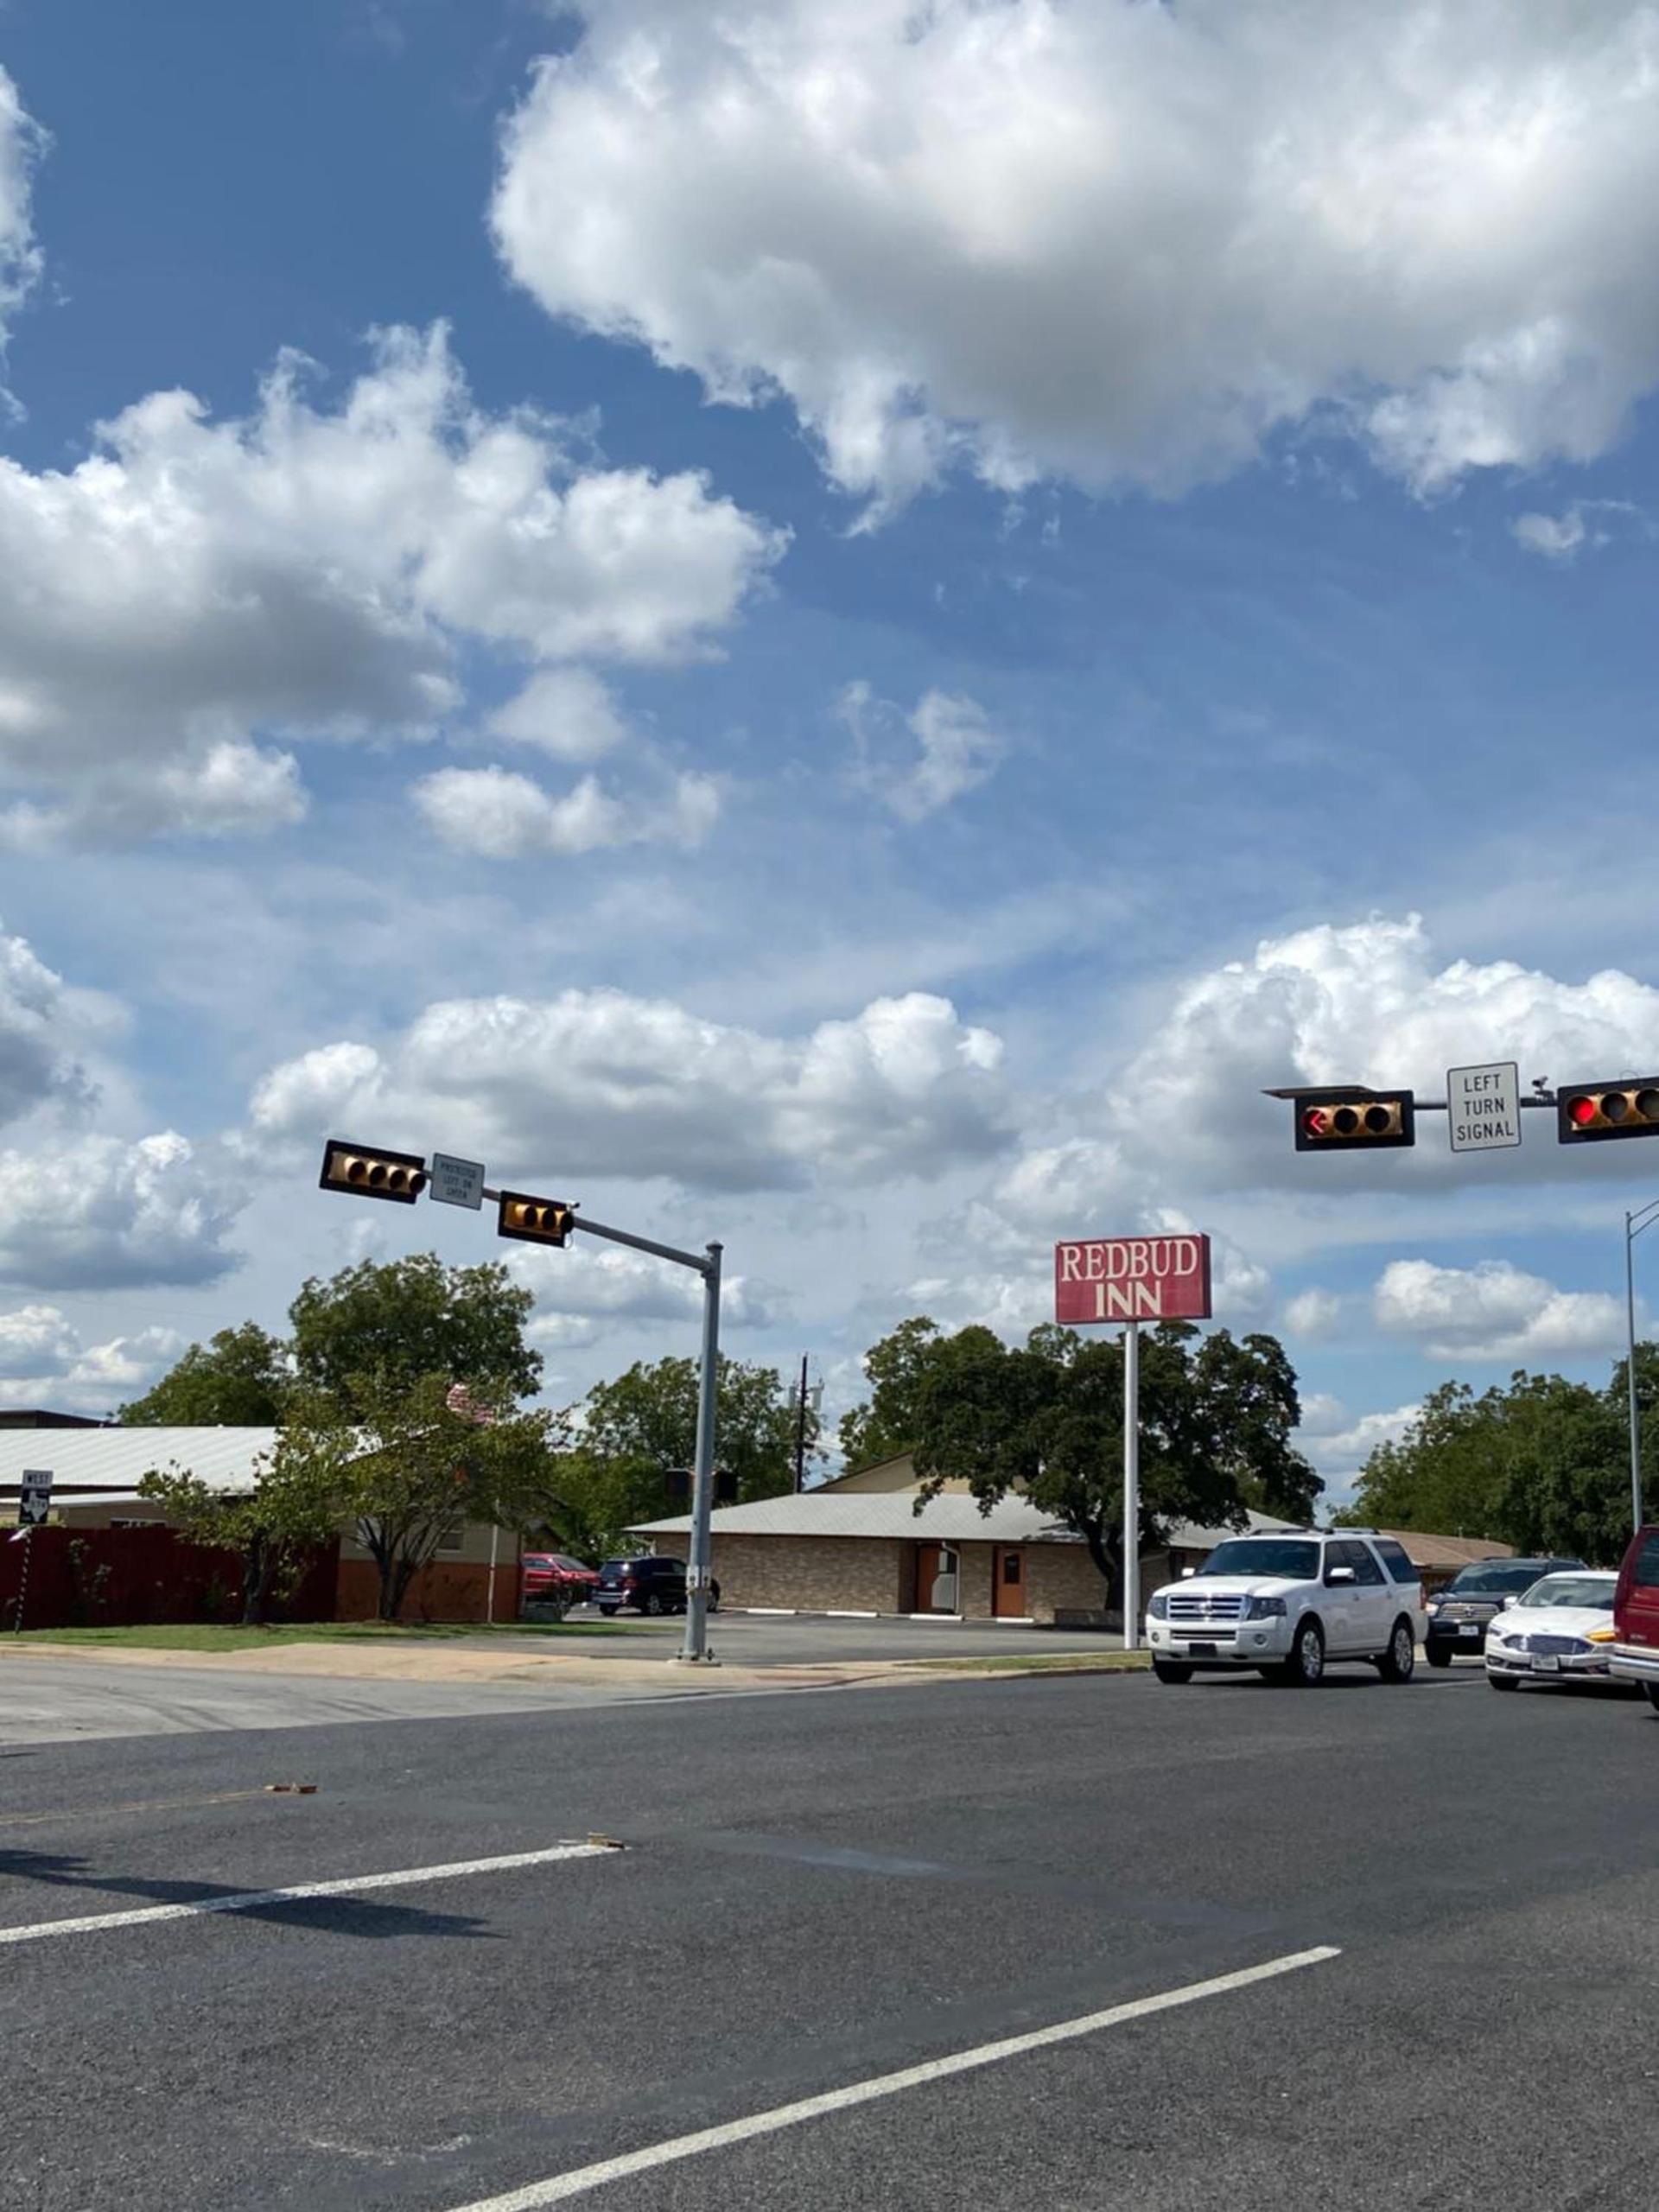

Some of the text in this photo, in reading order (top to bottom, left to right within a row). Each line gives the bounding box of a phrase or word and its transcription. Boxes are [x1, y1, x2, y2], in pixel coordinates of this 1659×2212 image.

[1464, 1074, 1501, 1093] LEFT
[1464, 1097, 1504, 1116] TURN
[1457, 1121, 1515, 1141] SIGNAL
[1060, 1239, 1198, 1281] REDBUD
[1096, 1281, 1161, 1318] INN
